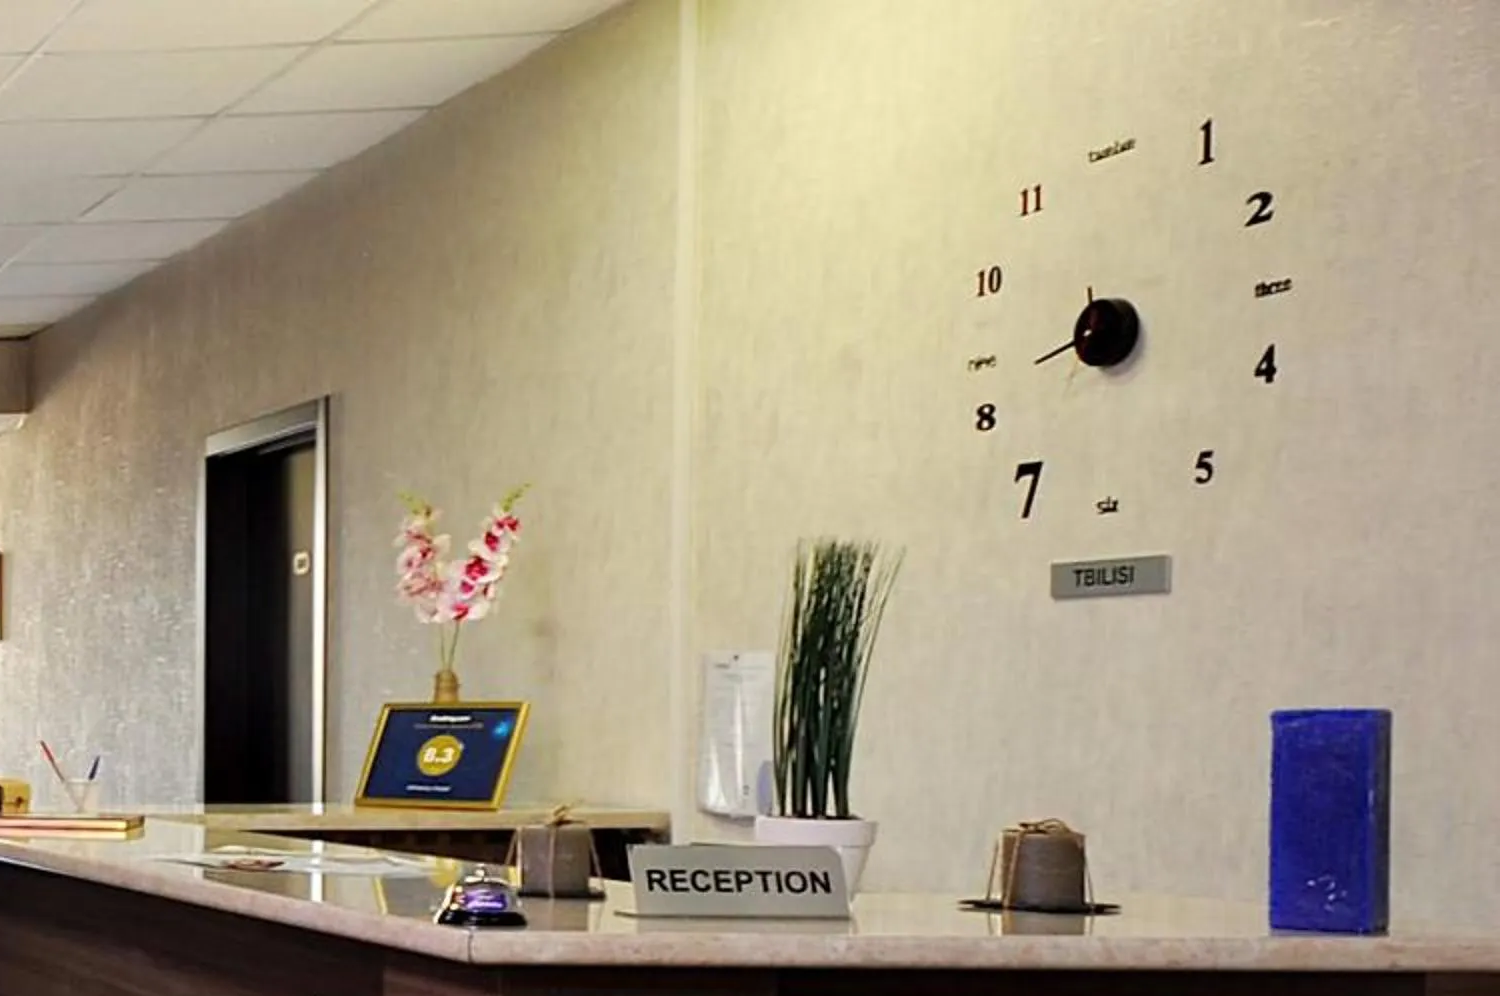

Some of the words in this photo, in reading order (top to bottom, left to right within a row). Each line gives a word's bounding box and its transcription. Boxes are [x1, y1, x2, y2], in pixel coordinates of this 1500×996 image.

[1199, 118, 1215, 165] 1
[1020, 184, 1043, 217] 11
[1244, 191, 1274, 227] 2
[977, 265, 1002, 297] 10
[1254, 344, 1277, 384] 4
[975, 403, 997, 432] 8
[1194, 450, 1214, 484] 5
[1014, 461, 1044, 519] 7
[1072, 565, 1135, 588] TBILISI
[645, 869, 832, 894] RECEPTION
